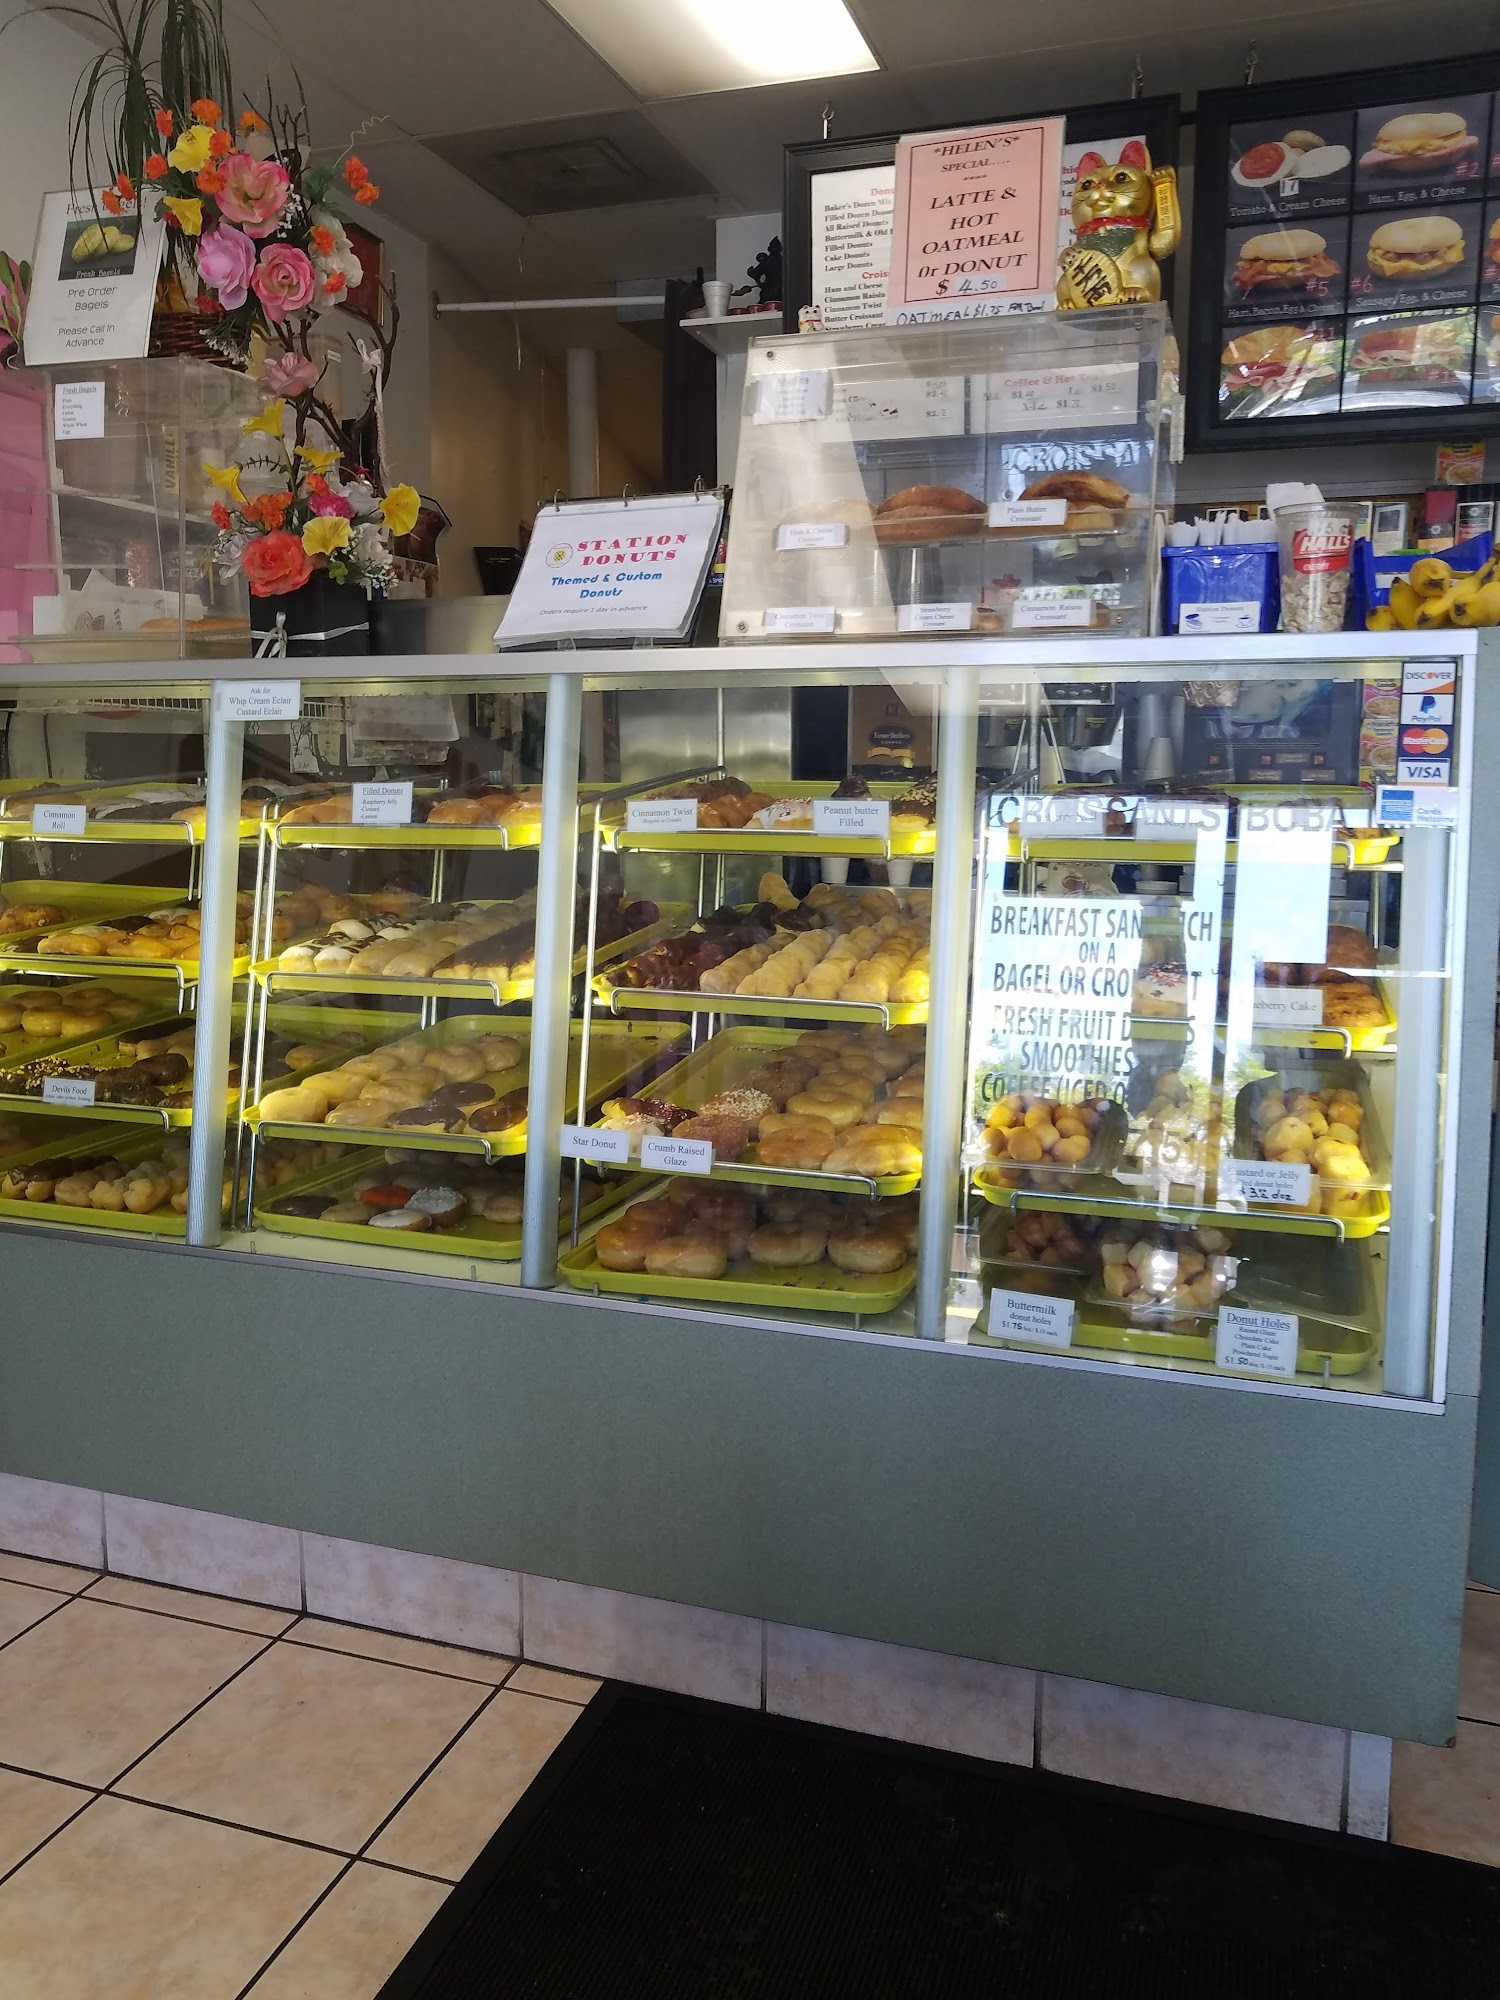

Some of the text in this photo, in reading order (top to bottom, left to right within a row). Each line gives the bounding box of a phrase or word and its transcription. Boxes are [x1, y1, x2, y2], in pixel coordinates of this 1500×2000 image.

[1431, 185, 1466, 198] Cheese
[853, 199, 876, 209] Dozen
[930, 187, 1018, 210] LATTE &
[1278, 201, 1310, 212] Cream
[1312, 196, 1347, 208] Cheese
[847, 211, 870, 220] Dozen
[949, 211, 999, 231] HOT
[836, 221, 860, 231] Raised
[862, 219, 889, 228] Donuts
[825, 231, 864, 242] Buttermilk
[922, 230, 1025, 255] OATMEAL
[825, 241, 873, 253] Filled Donuts
[825, 252, 870, 263] Cake Donuts
[847, 261, 873, 271] Donuts
[942, 253, 1028, 277] DONUT
[76, 268, 121, 279] Fresh Bagels
[68, 286, 117, 298] Pre Order
[825, 286, 842, 294] Ham
[858, 282, 884, 290] Cheese
[935, 278, 999, 297] $ 4.50
[825, 292, 886, 304] Cinnamon Raisin
[1431, 289, 1467, 301] Cheese
[75, 300, 109, 311] Bagels
[825, 302, 883, 314] Cinnamon Twist
[825, 312, 884, 324] Butter Croissant
[58, 326, 88, 336] Please
[90, 324, 107, 334] Call
[65, 338, 105, 348] Advance
[1004, 376, 1039, 387] Coffee
[577, 533, 690, 552] STATION
[1300, 535, 1351, 552] HALLS
[580, 549, 677, 567] DONUTS
[551, 571, 662, 586] Themed & Custom
[580, 587, 622, 599] Donuts
[564, 607, 589, 615] require
[596, 606, 609, 615] day
[1020, 604, 1056, 613] Cinnamon
[1405, 671, 1452, 680] DISCOVER
[250, 686, 271, 695] Ask for
[229, 696, 292, 706] Whip Cream Eclair
[236, 707, 283, 716] Custard Eclair
[1411, 715, 1442, 724] PayPal
[1407, 766, 1442, 779] VISA
[362, 787, 404, 796] Filled Donuts
[43, 809, 76, 820] Cinnamon
[632, 807, 693, 818] Cinnamon Twist
[823, 805, 879, 815] Peanut butter
[52, 821, 66, 830] Roll
[839, 817, 864, 827] Filled
[990, 905, 1102, 938] BREAKFAST
[1078, 941, 1116, 964] ON A
[993, 962, 1053, 993] BAGEL
[1059, 968, 1085, 995] OR
[1290, 1001, 1317, 1011] Cake
[991, 1005, 1053, 1036] FRESH
[1058, 1008, 1116, 1041] FRUIT
[1021, 1041, 1133, 1076] SMOOTHIES
[52, 1085, 88, 1095] Devils Food
[572, 1136, 617, 1150] Star Donut
[648, 1142, 705, 1156] Crumb Raised
[663, 1156, 688, 1167] Glaze
[1277, 1169, 1301, 1181] Jelly
[1007, 1298, 1057, 1316] Buttermilk
[1010, 1312, 1052, 1325] donut holes
[1227, 1312, 1291, 1330] Donut Holes
[1001, 1321, 1022, 1331] $1.75
[1234, 1334, 1279, 1345] Chocolate Cake
[1257, 1344, 1272, 1352] Cake
